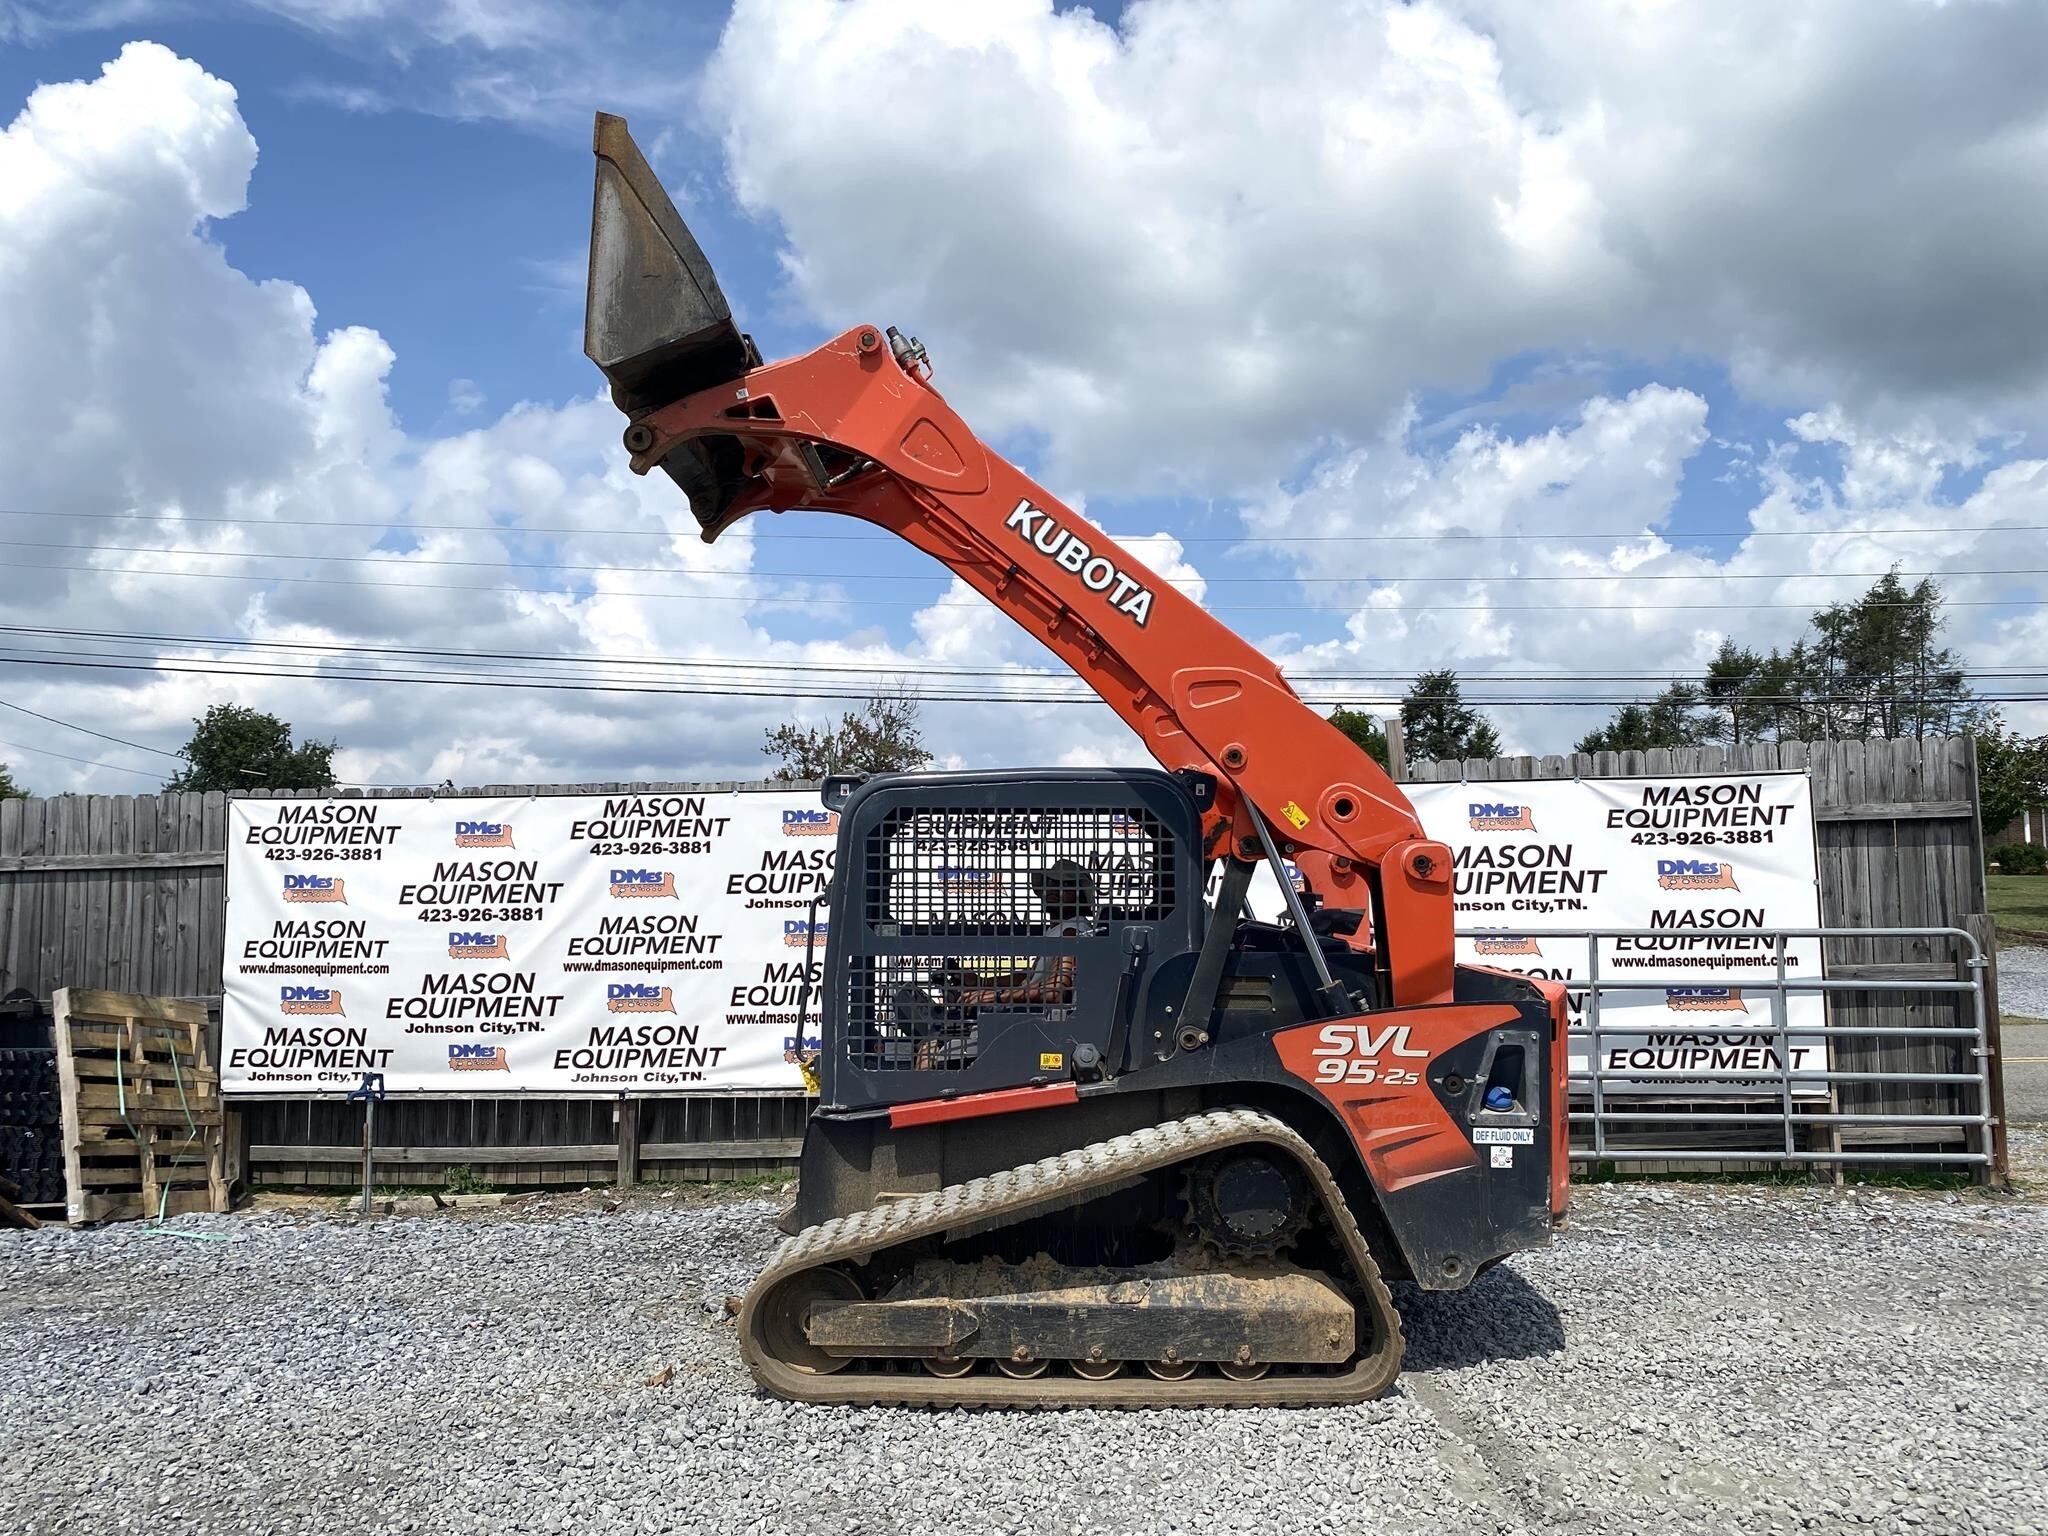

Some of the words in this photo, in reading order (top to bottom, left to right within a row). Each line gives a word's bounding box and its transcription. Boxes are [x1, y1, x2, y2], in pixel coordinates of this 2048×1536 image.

[1005, 498, 1154, 626] KUBOTA
[1642, 784, 1762, 806] MASON
[277, 805, 377, 824] MASON
[602, 797, 705, 818] MASON
[1606, 805, 1795, 829] EQUIPMENT
[245, 826, 401, 845] EQUIPMENT
[570, 818, 731, 840] EQUIPMENT
[1630, 830, 1774, 845] 423-926-3881
[264, 848, 382, 861] 423-926-3881
[590, 841, 711, 856] 423-926-3881
[432, 861, 538, 882] MASON
[1453, 870, 1608, 895] UIPMENT
[399, 883, 564, 905] EQUIPMENT
[418, 908, 544, 922] 423-926-3881
[599, 915, 698, 935] MASON
[1650, 908, 1765, 929] MASON
[272, 920, 366, 939] MASON
[243, 940, 389, 959] EQUIPMENT
[567, 935, 722, 956] EQUIPMENT
[239, 962, 390, 977] www.dmasonequipment.com
[563, 958, 723, 973] www.dmasonequipment.com
[421, 972, 536, 995] MASON
[386, 996, 564, 1019] EQUIPMENT
[263, 1027, 367, 1047] MASON
[405, 1022, 474, 1034] Johnson
[588, 1025, 699, 1047] MASON
[1311, 1024, 1430, 1058] SVL
[229, 1049, 394, 1068] EQUIPMENT
[553, 1047, 726, 1069] EQUIPMENT
[247, 1071, 312, 1083] Johnson
[571, 1073, 638, 1083] Johnson
[1475, 1130, 1490, 1141] DEF
[1490, 1130, 1512, 1141] FLUID
[1512, 1131, 1531, 1141] ONLY
